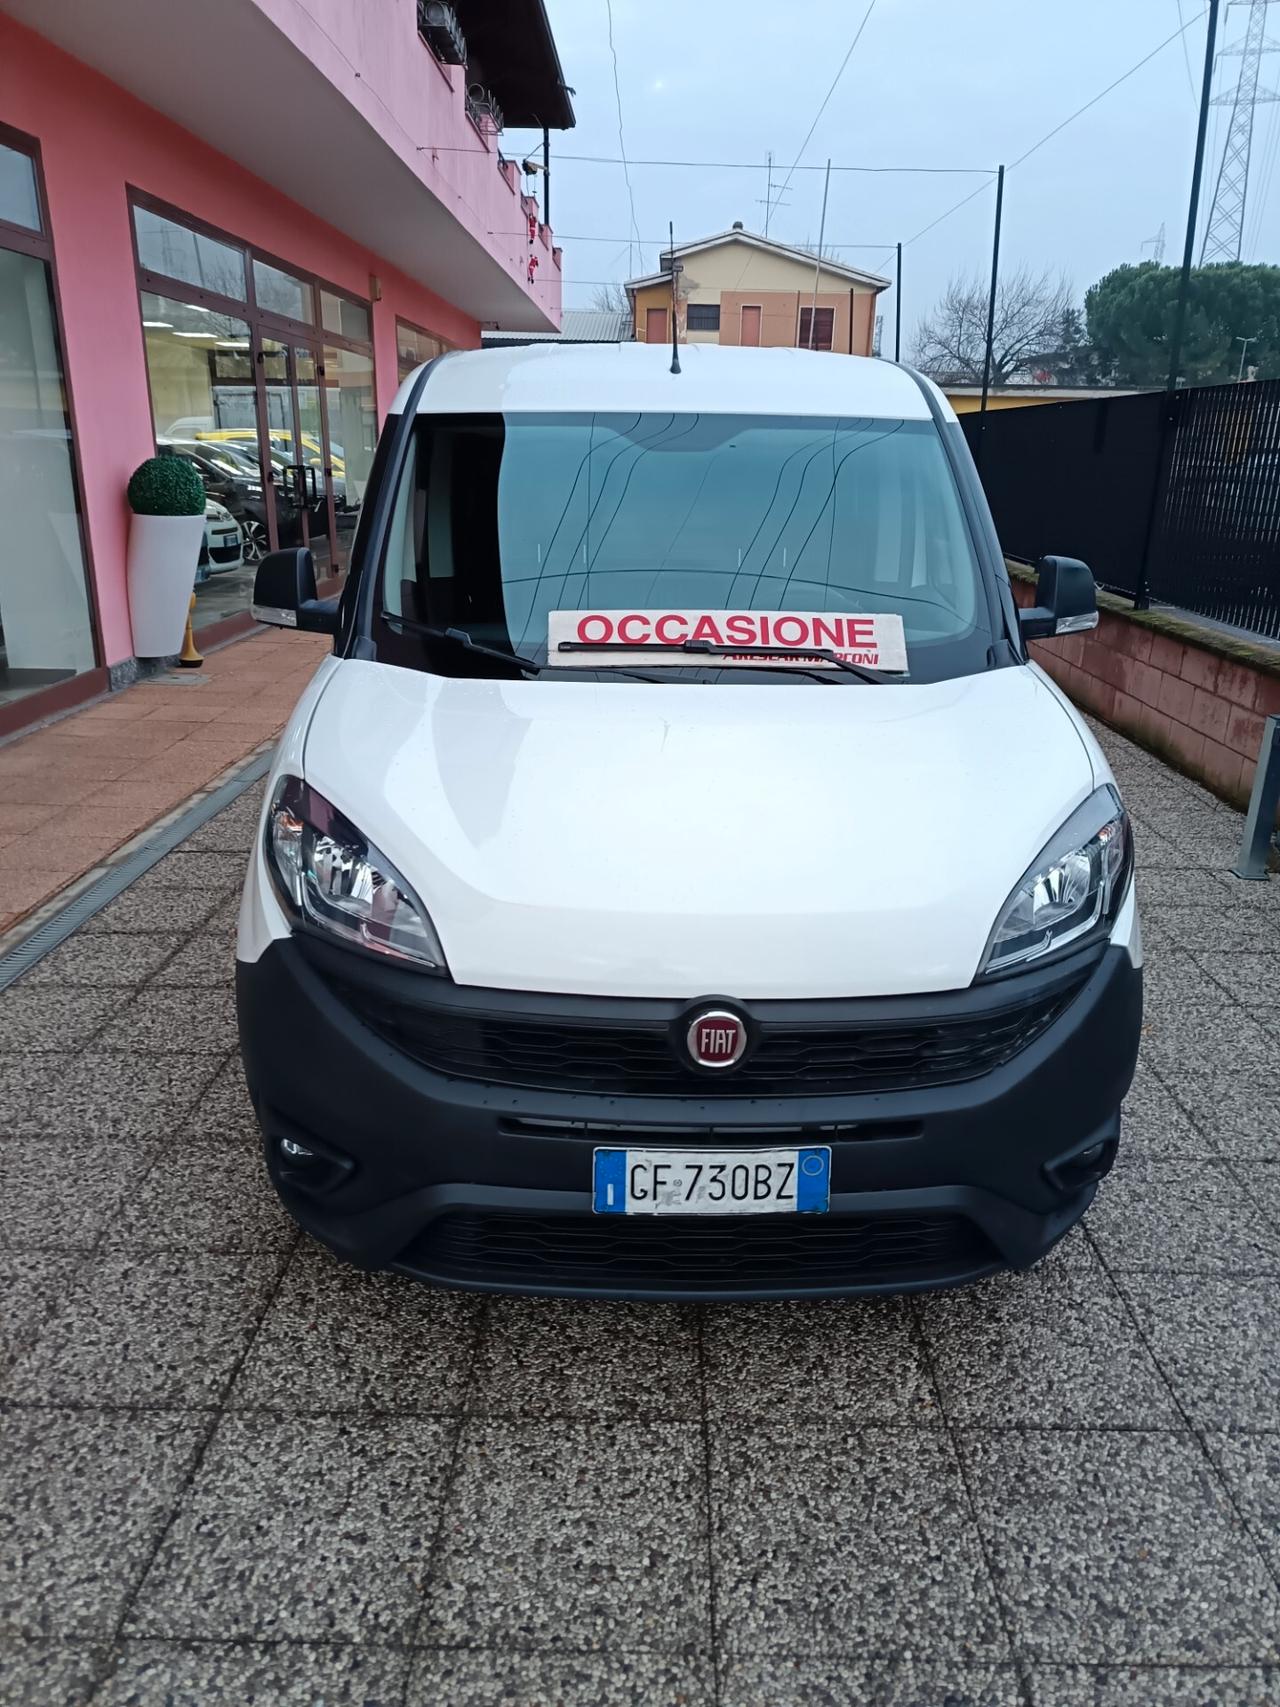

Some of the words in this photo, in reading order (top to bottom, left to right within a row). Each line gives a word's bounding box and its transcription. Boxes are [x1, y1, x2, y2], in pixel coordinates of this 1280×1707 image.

[577, 614, 878, 648] OCCASIONE
[803, 652, 879, 665] MRCONI
[701, 1028, 736, 1054] FIAT
